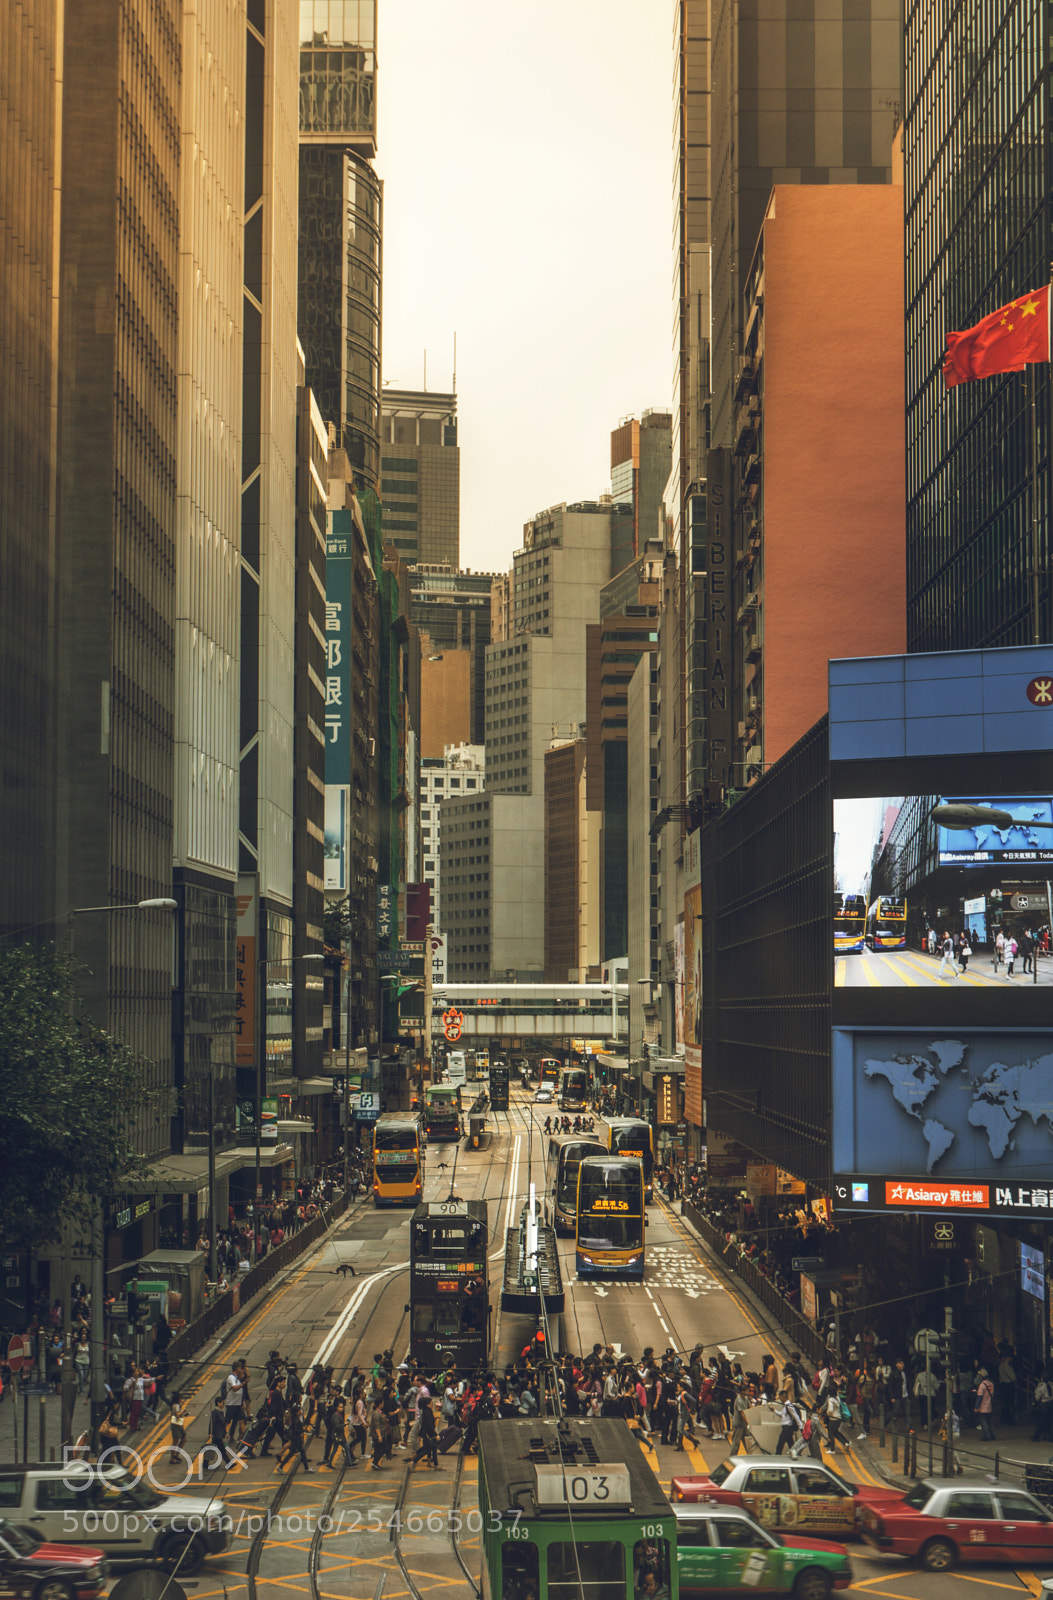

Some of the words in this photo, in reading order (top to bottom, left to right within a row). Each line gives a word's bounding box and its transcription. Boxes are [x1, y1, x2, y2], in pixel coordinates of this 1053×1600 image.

[328, 544, 347, 553] 銀行
[711, 483, 726, 711] SIBERIAN
[905, 1188, 948, 1205] Asiaray
[950, 1189, 984, 1203] 雅仕維
[995, 1188, 1053, 1208] 以上資
[440, 1204, 457, 1214] 90
[618, 1200, 629, 1210] 5B
[562, 1476, 610, 1501] 103
[505, 1527, 529, 1539] 103
[641, 1524, 664, 1538] 103
